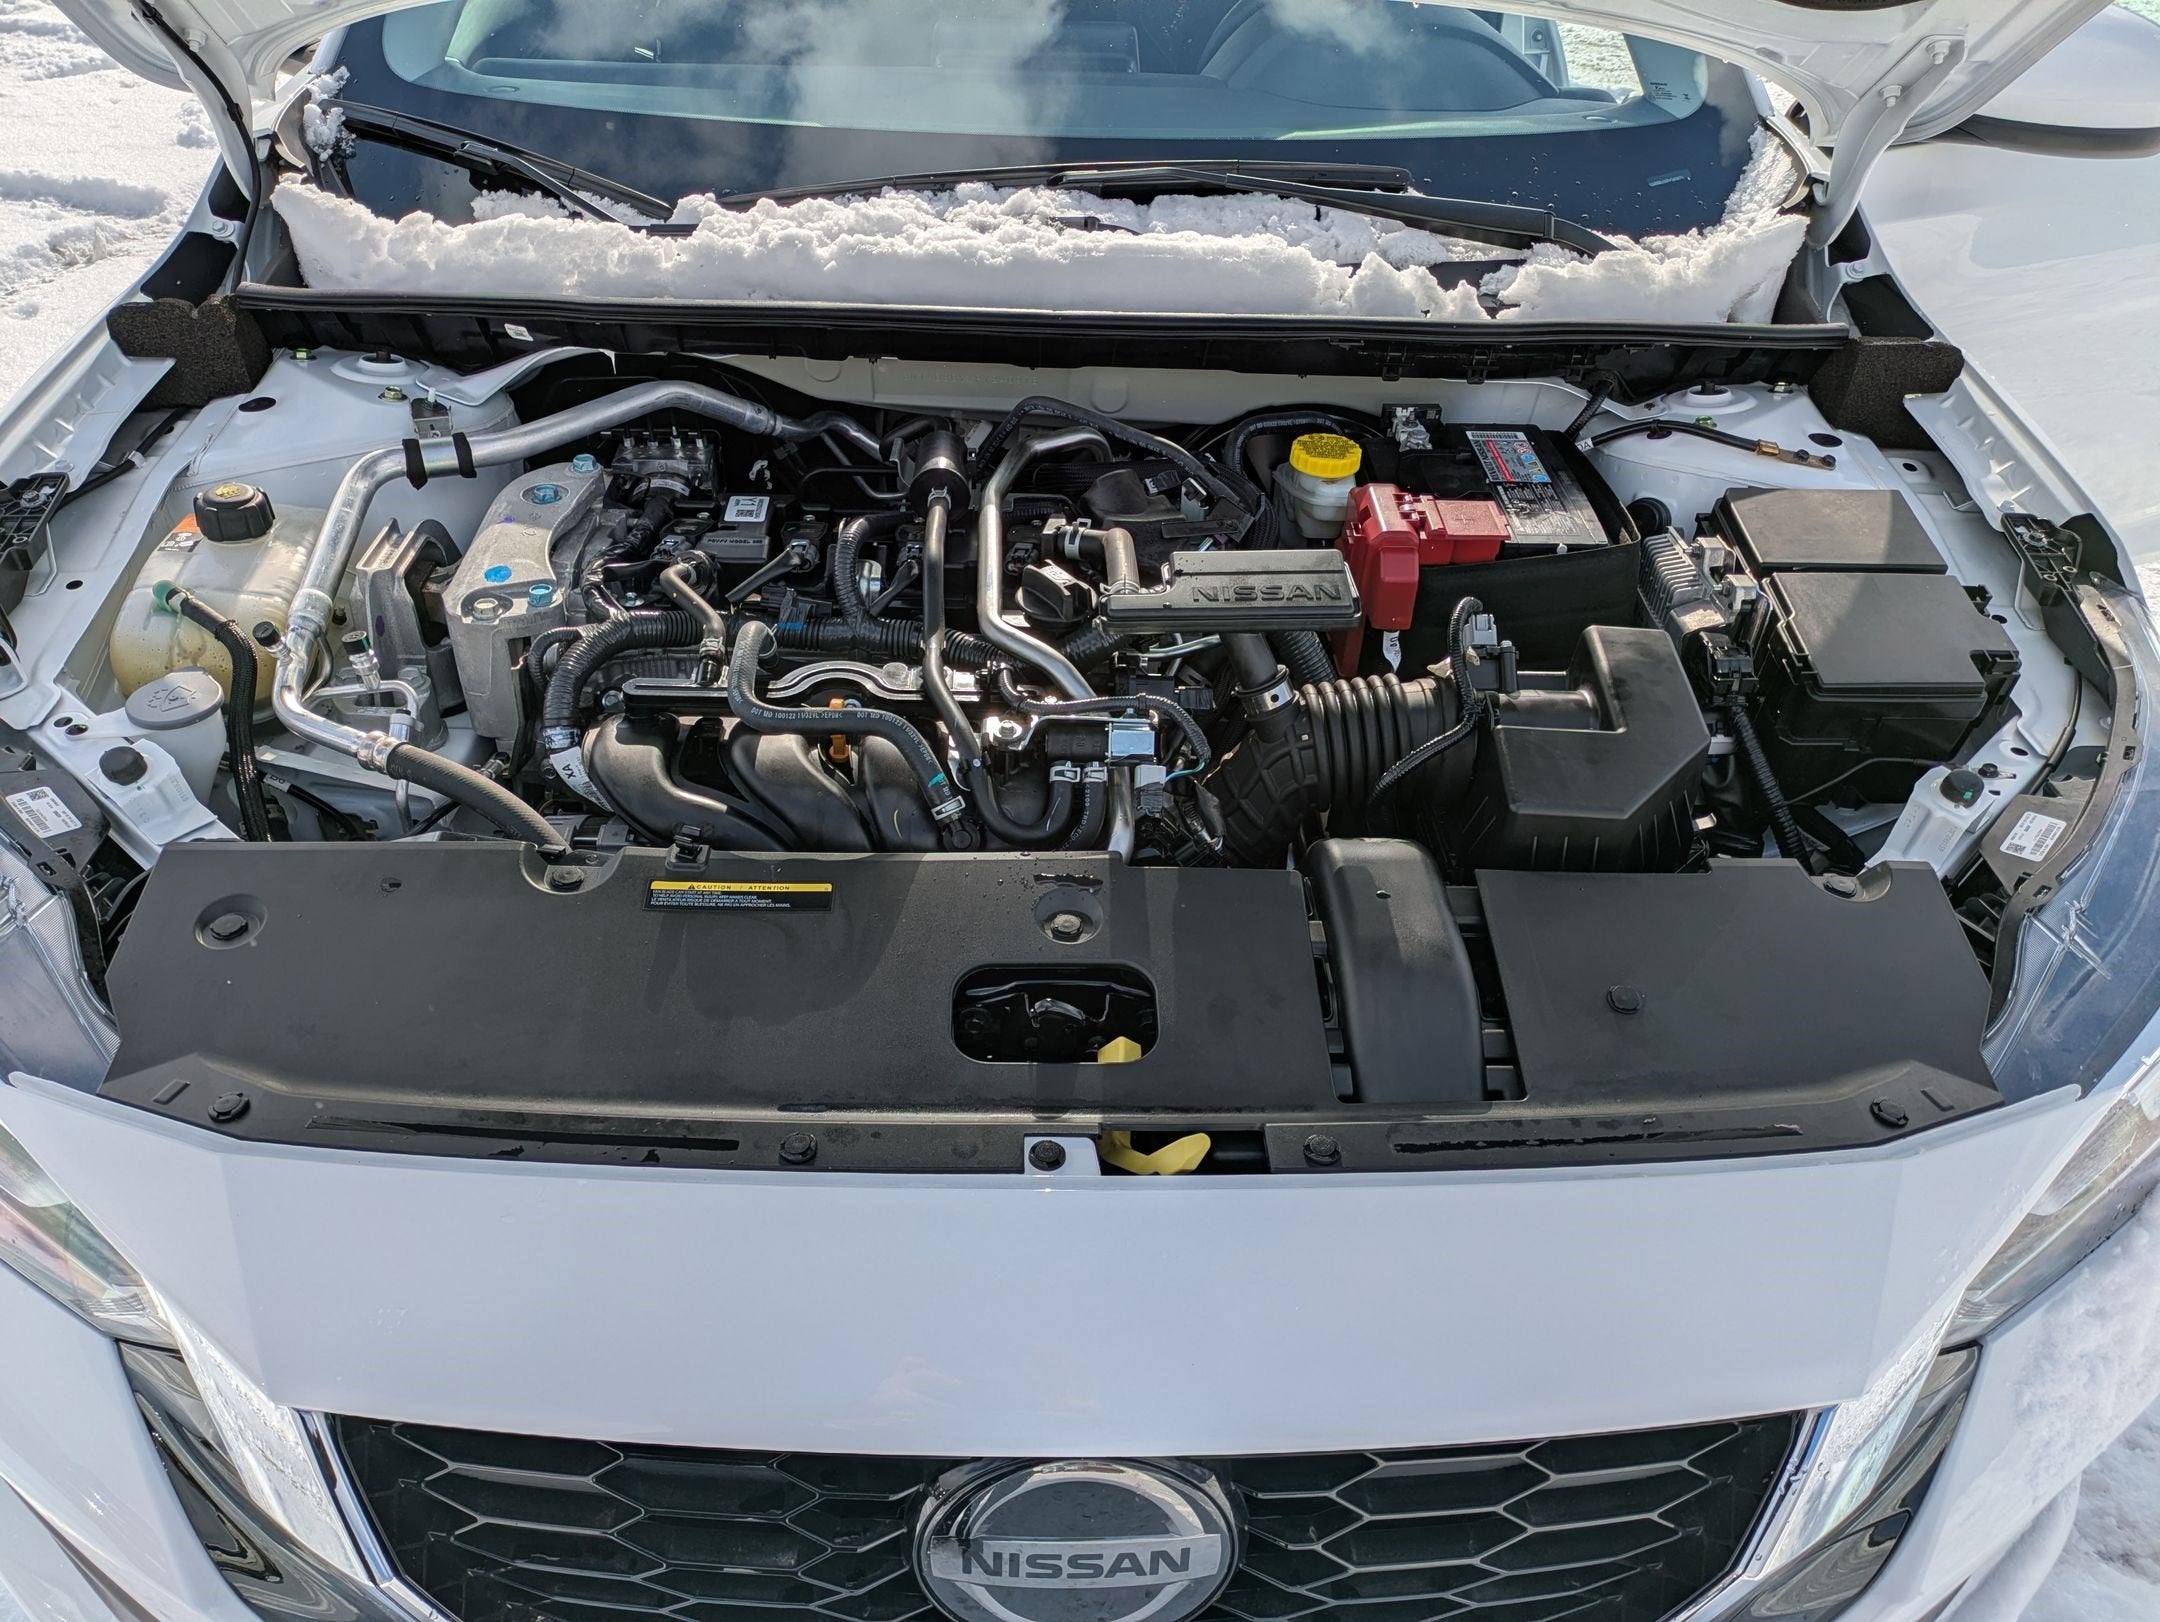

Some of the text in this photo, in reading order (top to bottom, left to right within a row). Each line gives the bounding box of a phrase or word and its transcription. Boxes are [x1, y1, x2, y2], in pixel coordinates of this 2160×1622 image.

[1192, 584, 1342, 602] NISSAN
[562, 763, 577, 779] XA
[961, 1547, 1191, 1579] NISSAN
